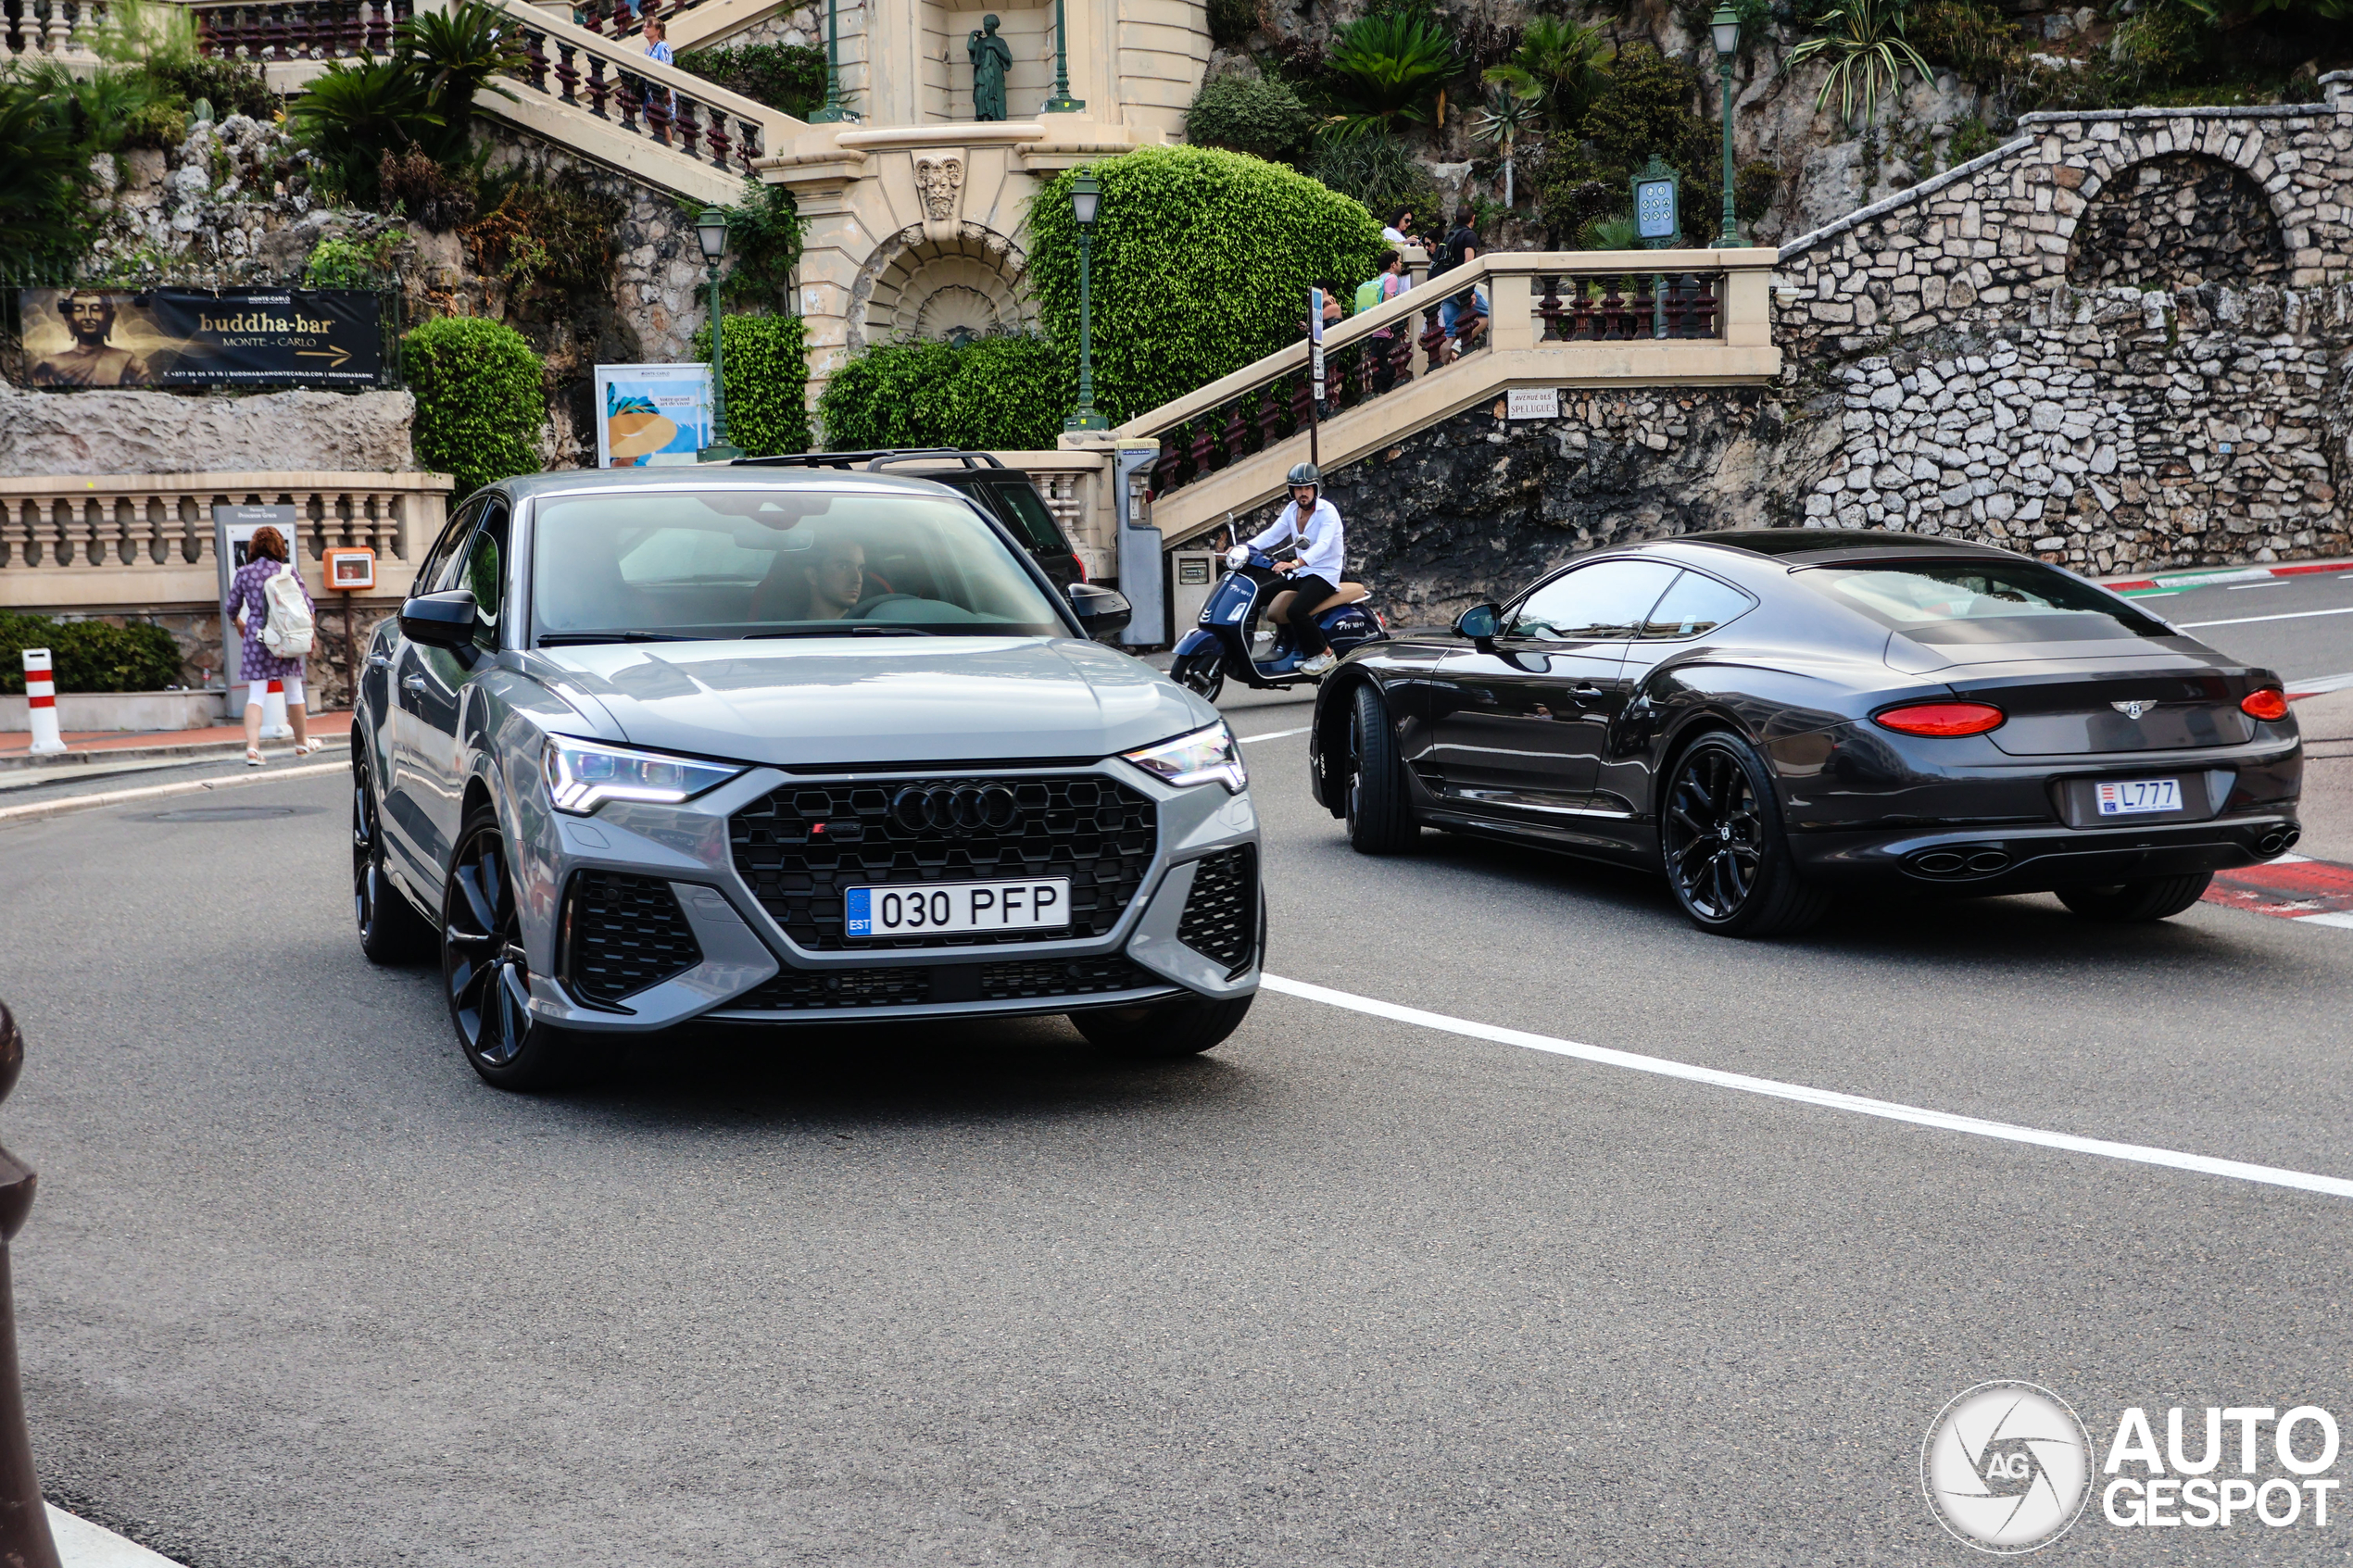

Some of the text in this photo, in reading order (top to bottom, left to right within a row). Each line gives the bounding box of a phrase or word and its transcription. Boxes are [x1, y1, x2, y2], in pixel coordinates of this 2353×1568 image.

[198, 311, 332, 333] buddha-bar
[222, 337, 268, 346] MONTE
[277, 337, 317, 346] CARLO
[1511, 405, 1556, 413] SPELUGUES
[2131, 704, 2140, 714] B
[2121, 782, 2173, 806] L777
[882, 884, 1057, 928] 030 PFP
[849, 919, 870, 930] EST
